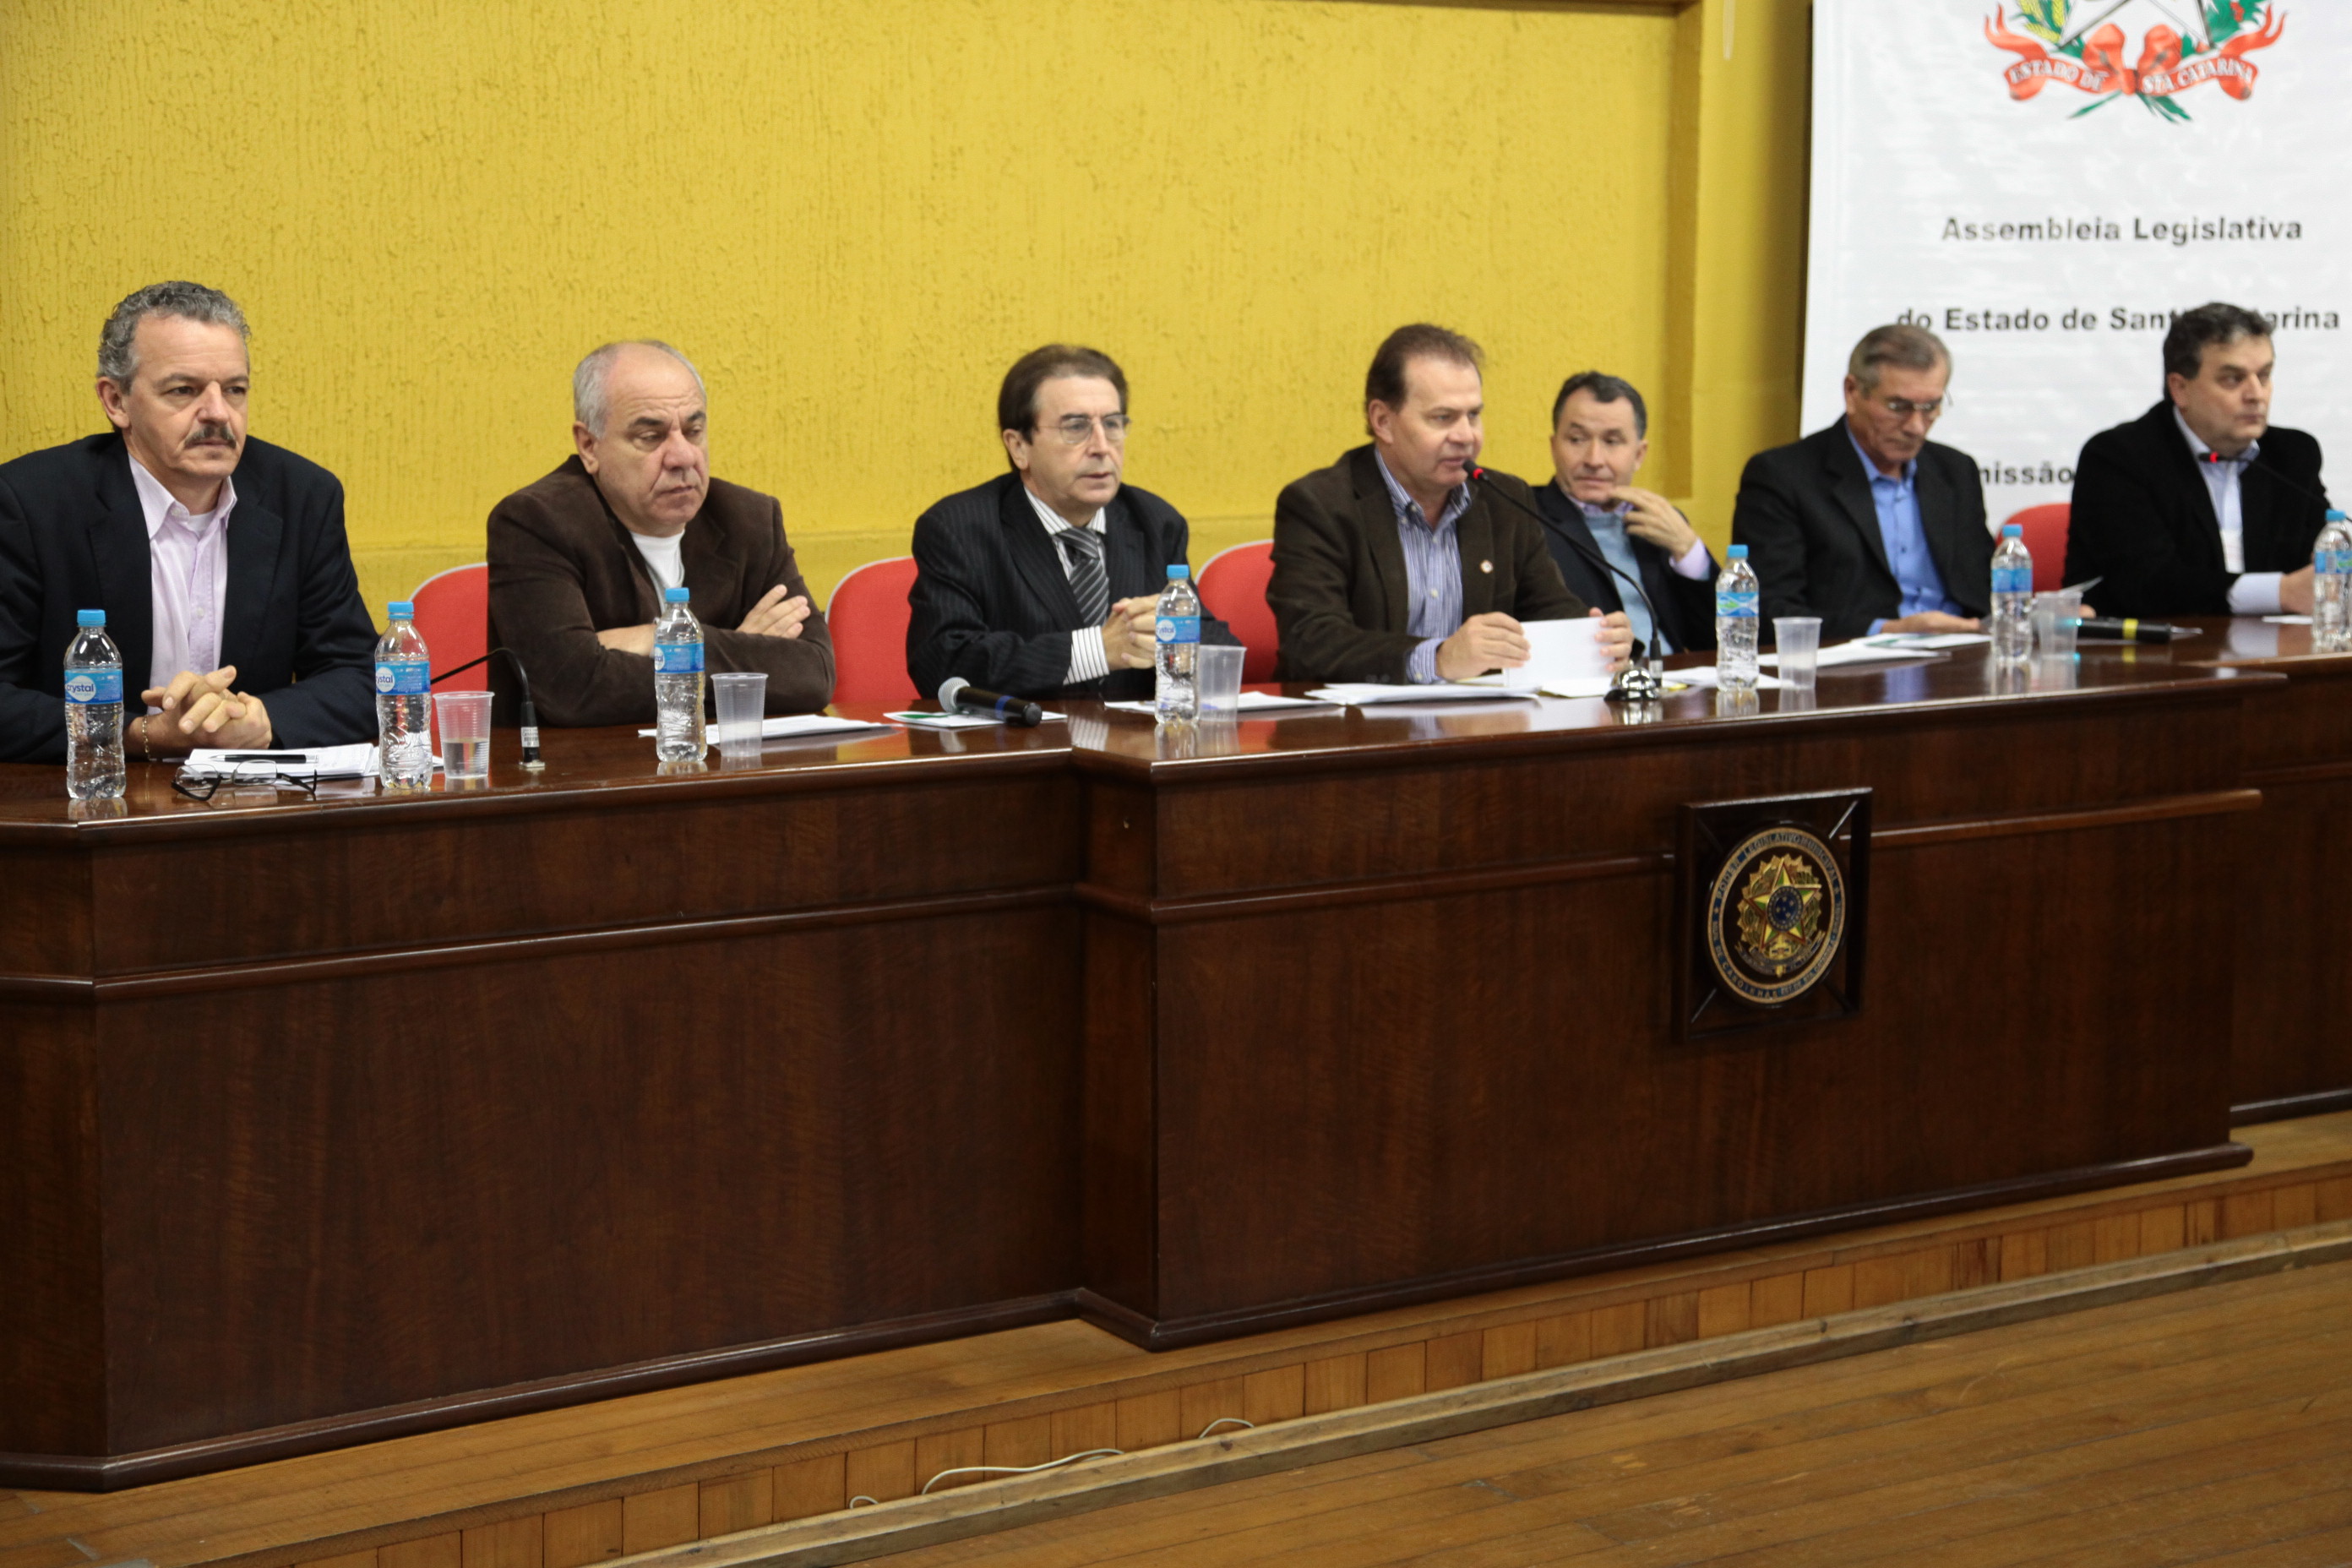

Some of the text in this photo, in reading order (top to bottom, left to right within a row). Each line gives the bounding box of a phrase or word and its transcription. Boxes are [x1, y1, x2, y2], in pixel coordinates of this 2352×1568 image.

[2009, 58, 2253, 93] ESTADO DE STA CATARINA
[1942, 216, 2302, 246] Assembleia Legislativa
[1897, 308, 1932, 329] do
[1946, 308, 2049, 331] Estado
[2062, 308, 2097, 331] de
[2265, 307, 2340, 329] arina
